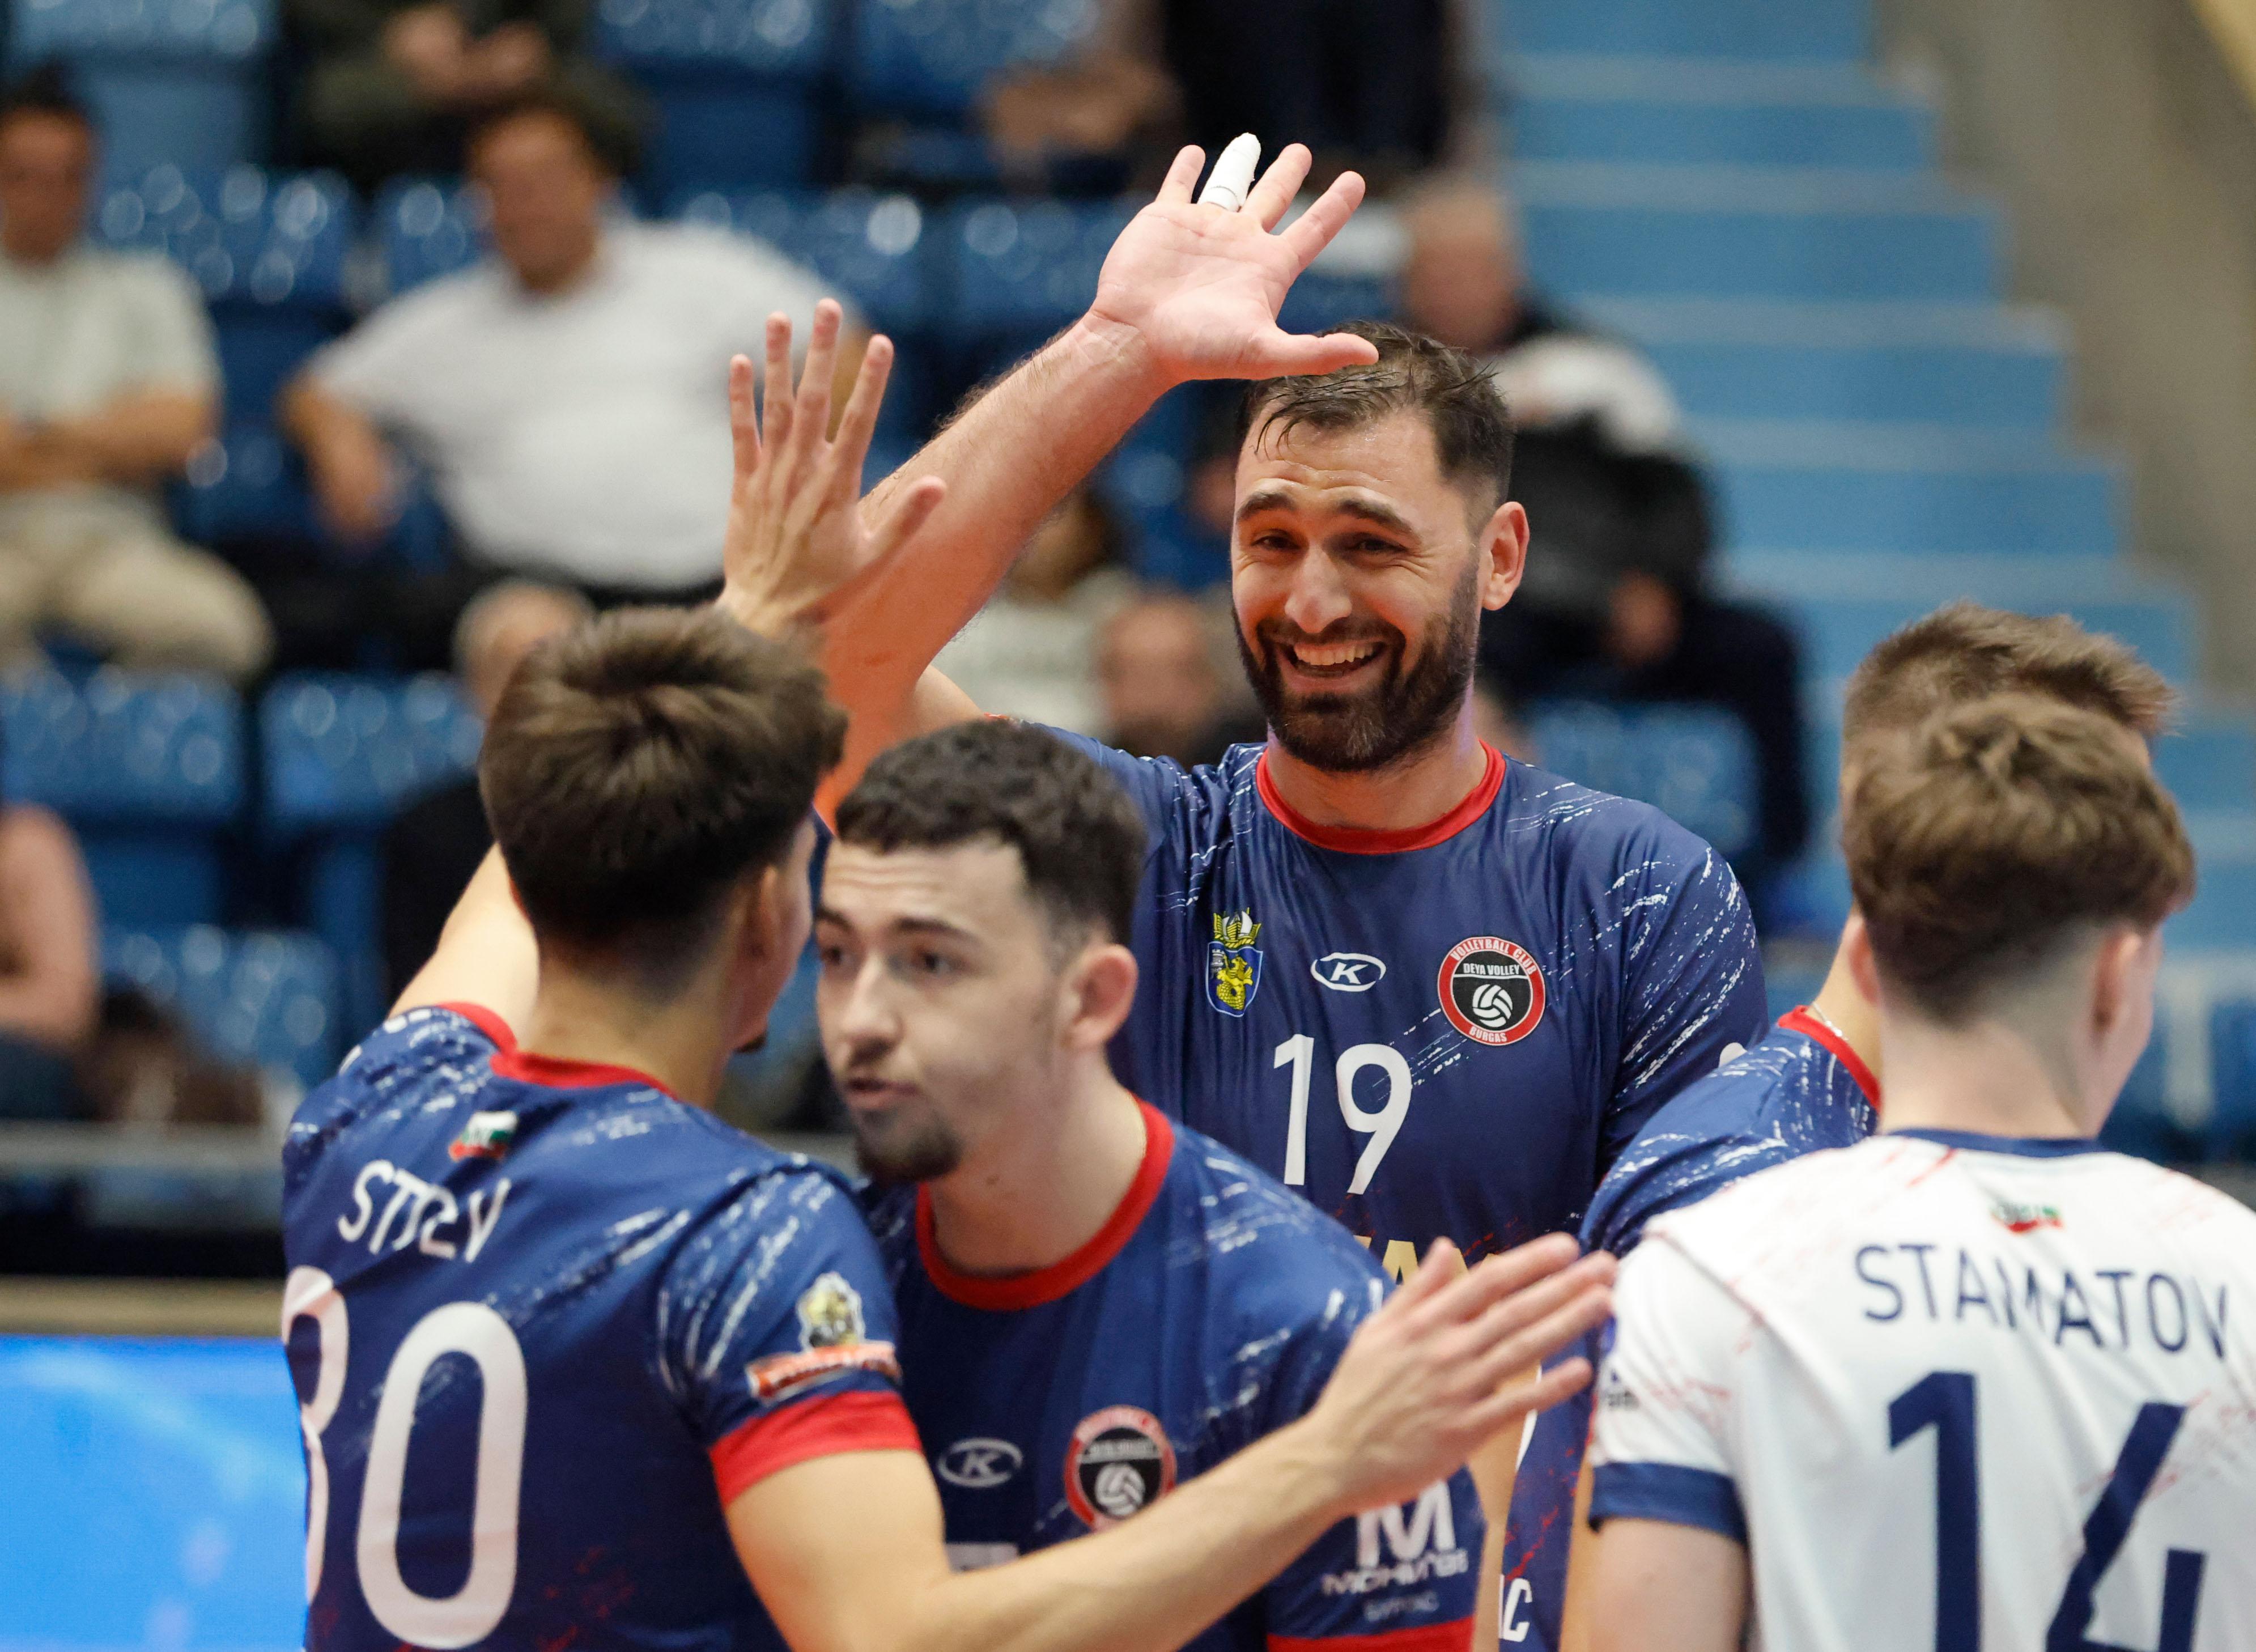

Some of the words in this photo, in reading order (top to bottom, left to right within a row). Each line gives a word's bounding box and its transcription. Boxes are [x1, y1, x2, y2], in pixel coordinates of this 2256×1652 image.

[1450, 938, 1510, 961] VOLLEYBALL
[1512, 948, 1537, 975] CLUB
[1463, 963, 1486, 975] DEYA
[1486, 964, 1520, 976] VOLLEY
[1468, 1026, 1507, 1042] BURGAS
[1273, 1033, 1413, 1195] 19
[1888, 1370, 2206, 1652] 14
